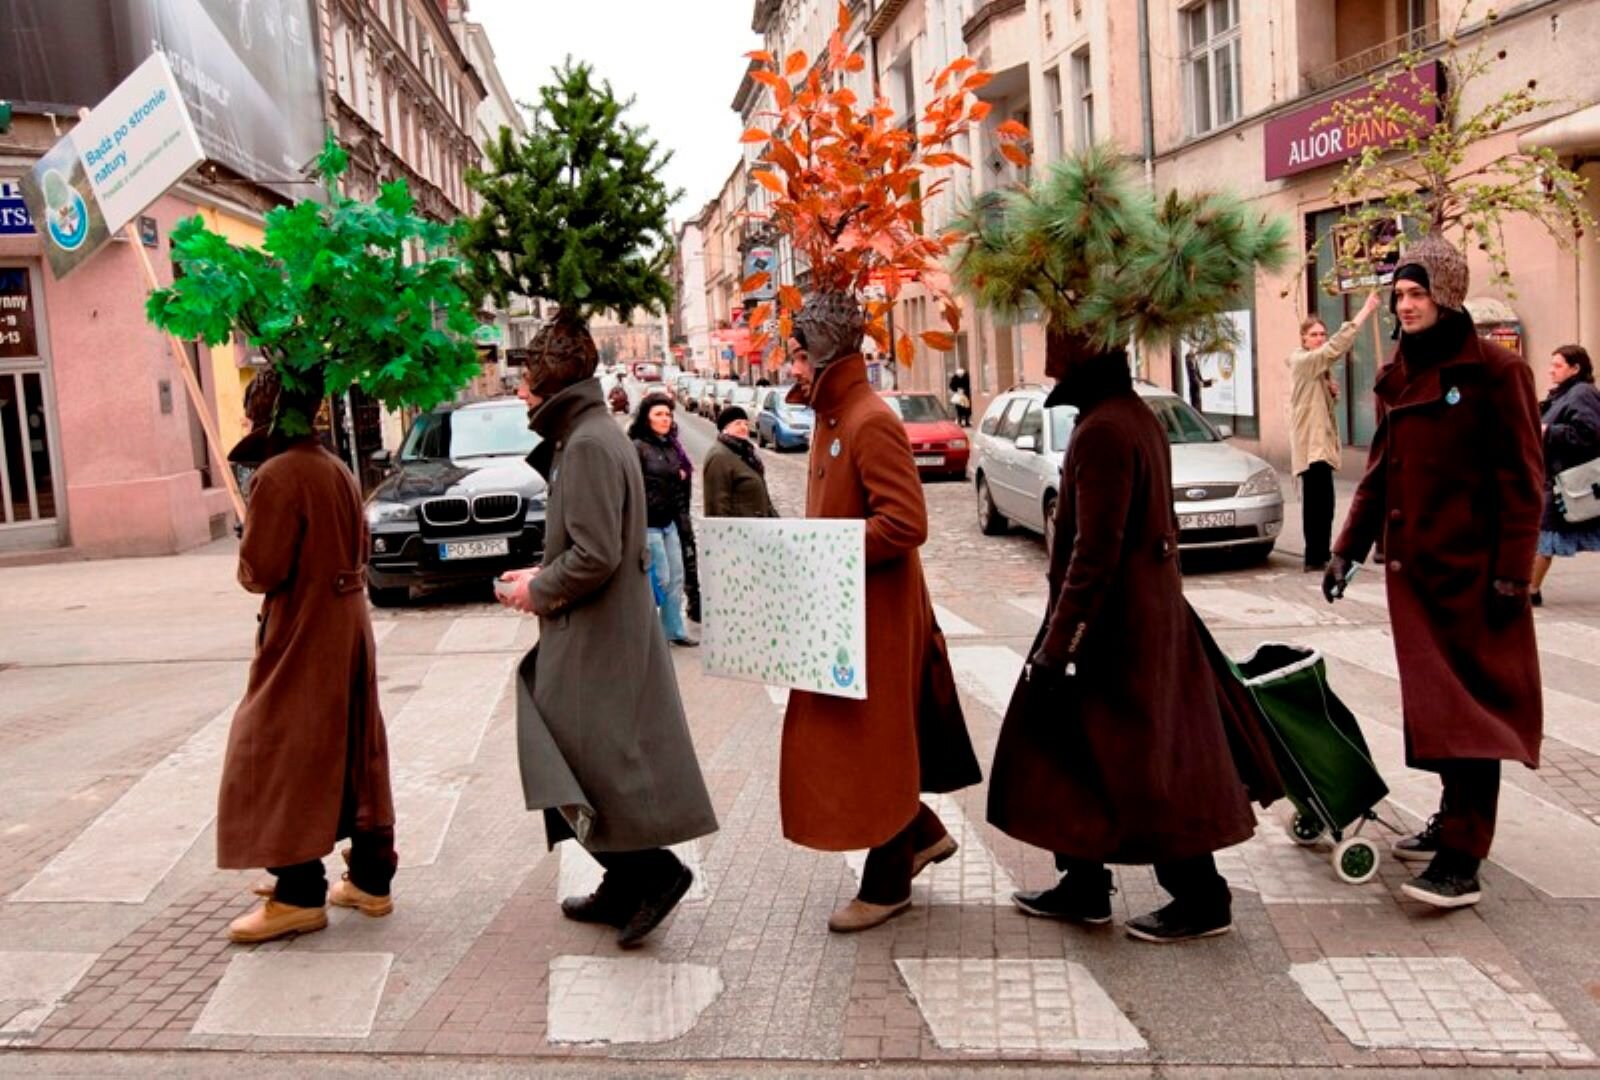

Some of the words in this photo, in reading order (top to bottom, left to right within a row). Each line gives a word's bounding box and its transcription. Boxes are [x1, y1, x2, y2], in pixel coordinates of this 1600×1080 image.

[114, 125, 128, 146] po
[129, 88, 166, 128] stronie
[1288, 128, 1342, 167] ALIOR
[95, 150, 127, 185] natury
